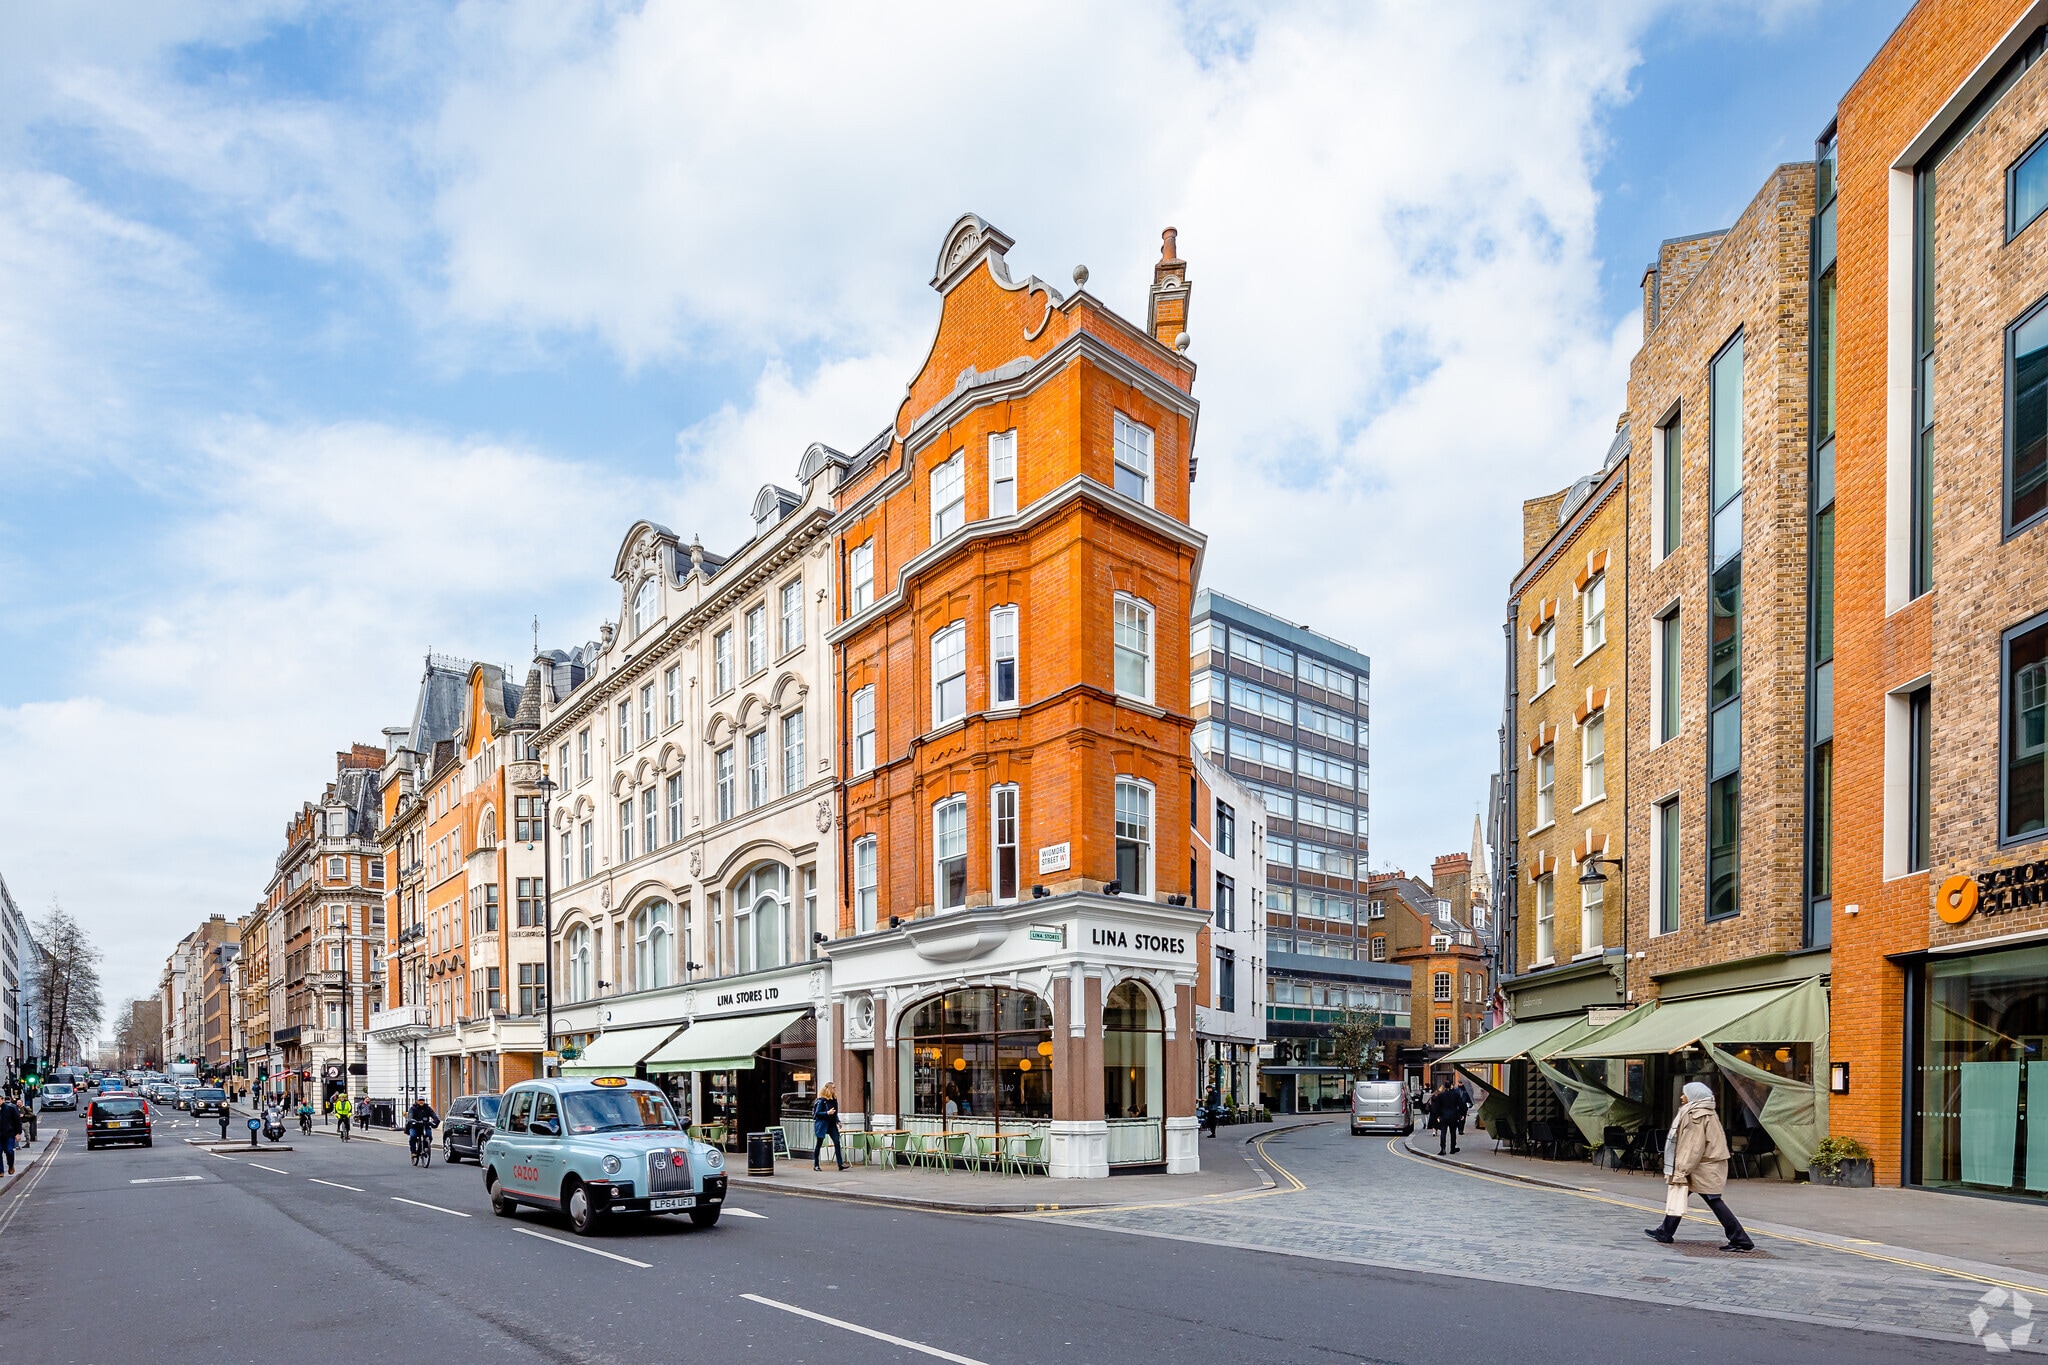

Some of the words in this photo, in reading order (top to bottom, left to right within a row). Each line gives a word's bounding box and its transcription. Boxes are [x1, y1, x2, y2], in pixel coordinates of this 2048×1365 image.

[1042, 846, 1065, 857] WIGMORE
[1042, 856, 1059, 865] STREET
[1092, 928, 1127, 948] LINA
[1135, 934, 1184, 954] STORES
[717, 994, 733, 1006] LINA
[736, 989, 762, 1004] STORES
[765, 988, 779, 1000] LTD
[513, 1165, 539, 1182] CAZOO
[654, 1199, 676, 1209] LP64
[677, 1198, 693, 1207] UFD
